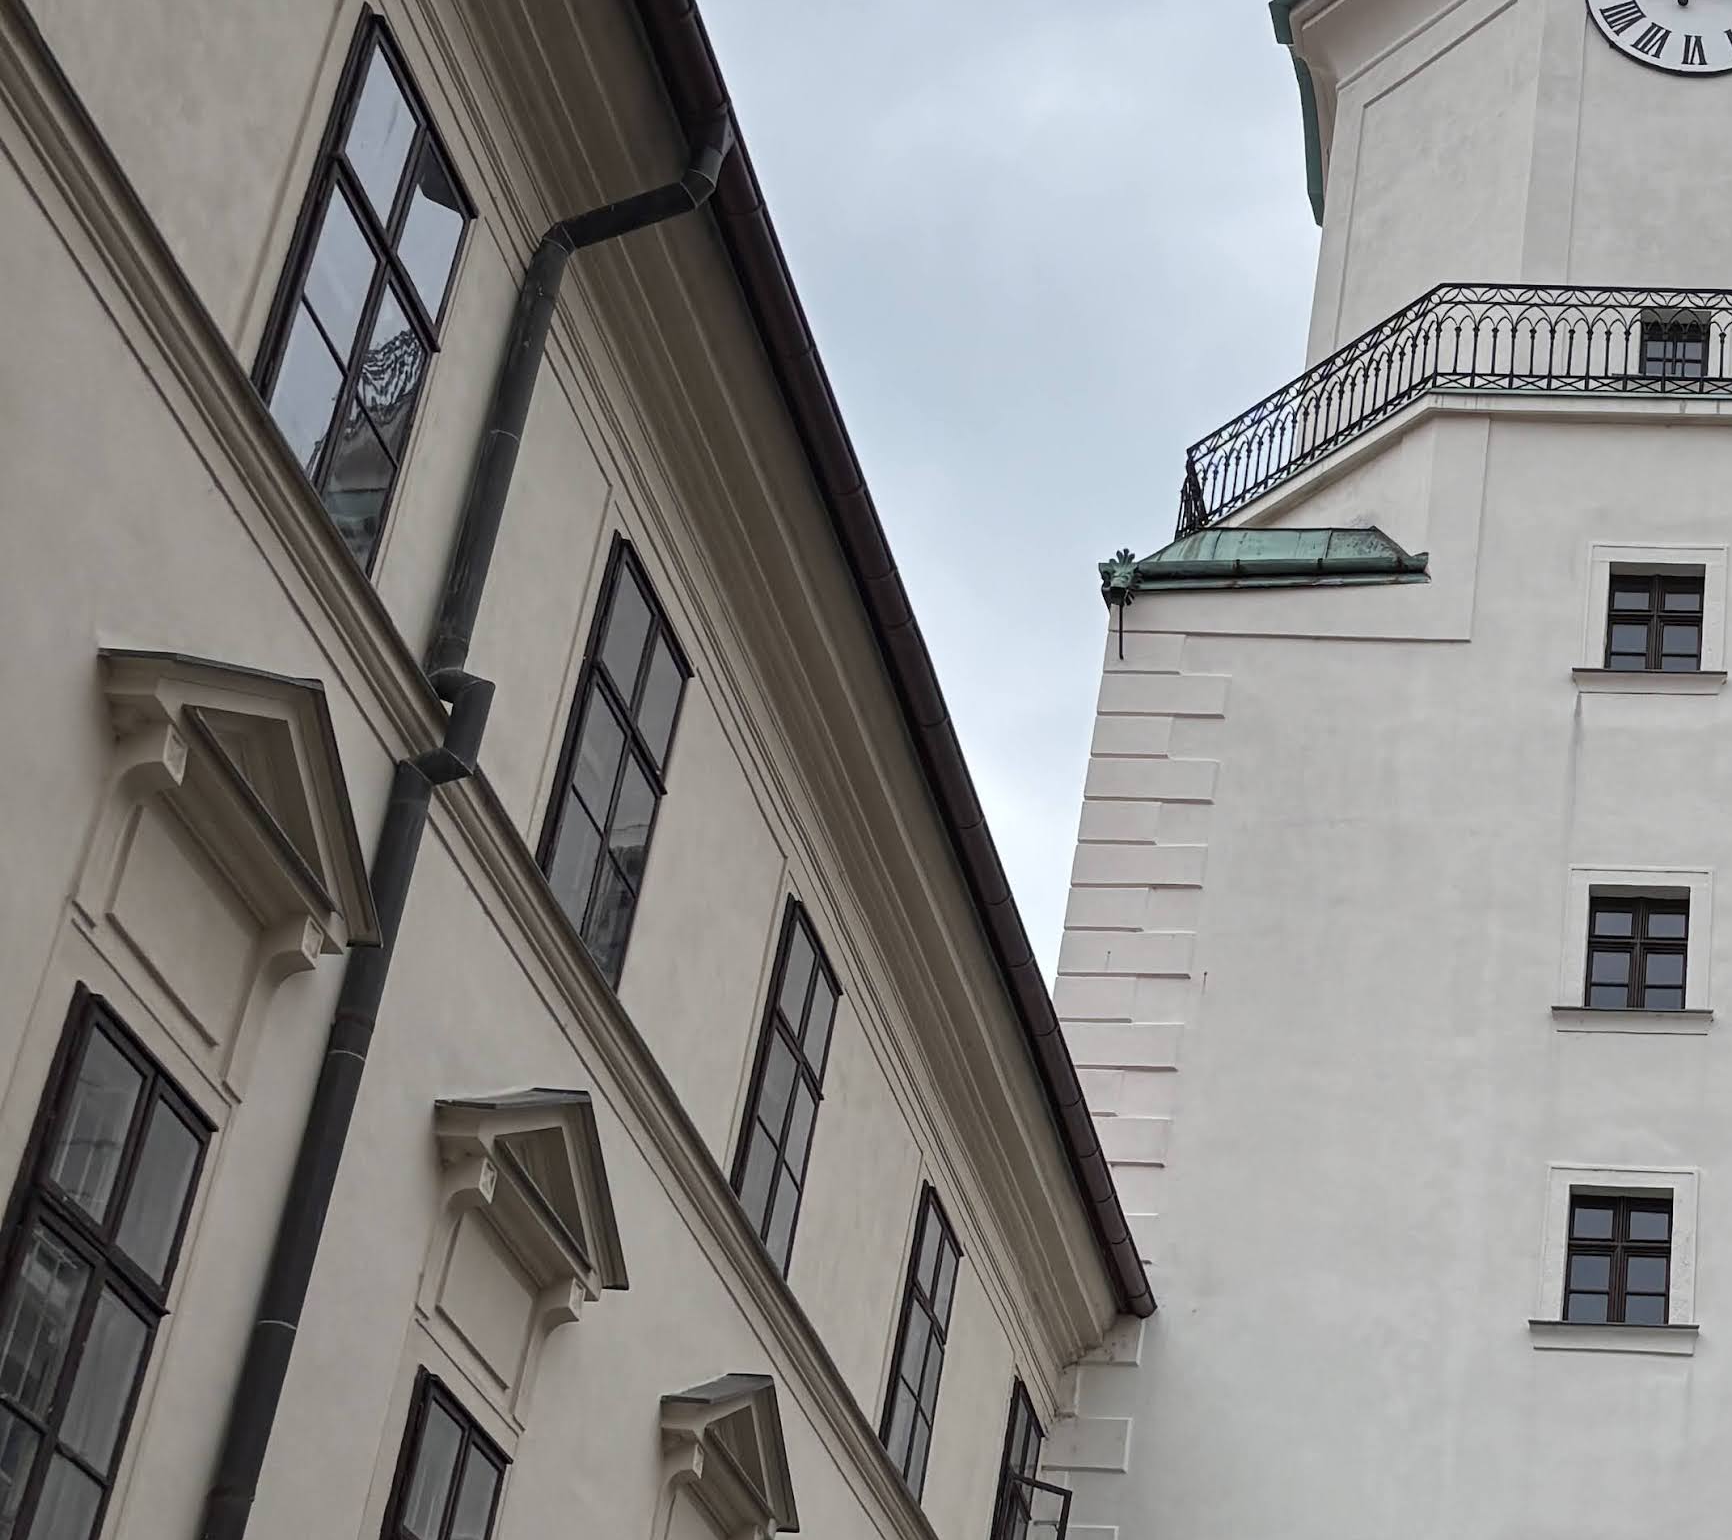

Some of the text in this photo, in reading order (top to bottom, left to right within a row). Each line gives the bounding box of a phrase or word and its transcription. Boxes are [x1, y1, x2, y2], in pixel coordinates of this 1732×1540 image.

[1599, 0, 1647, 37] VIII
[1631, 22, 1672, 59] VII
[1681, 34, 1708, 65] VI
